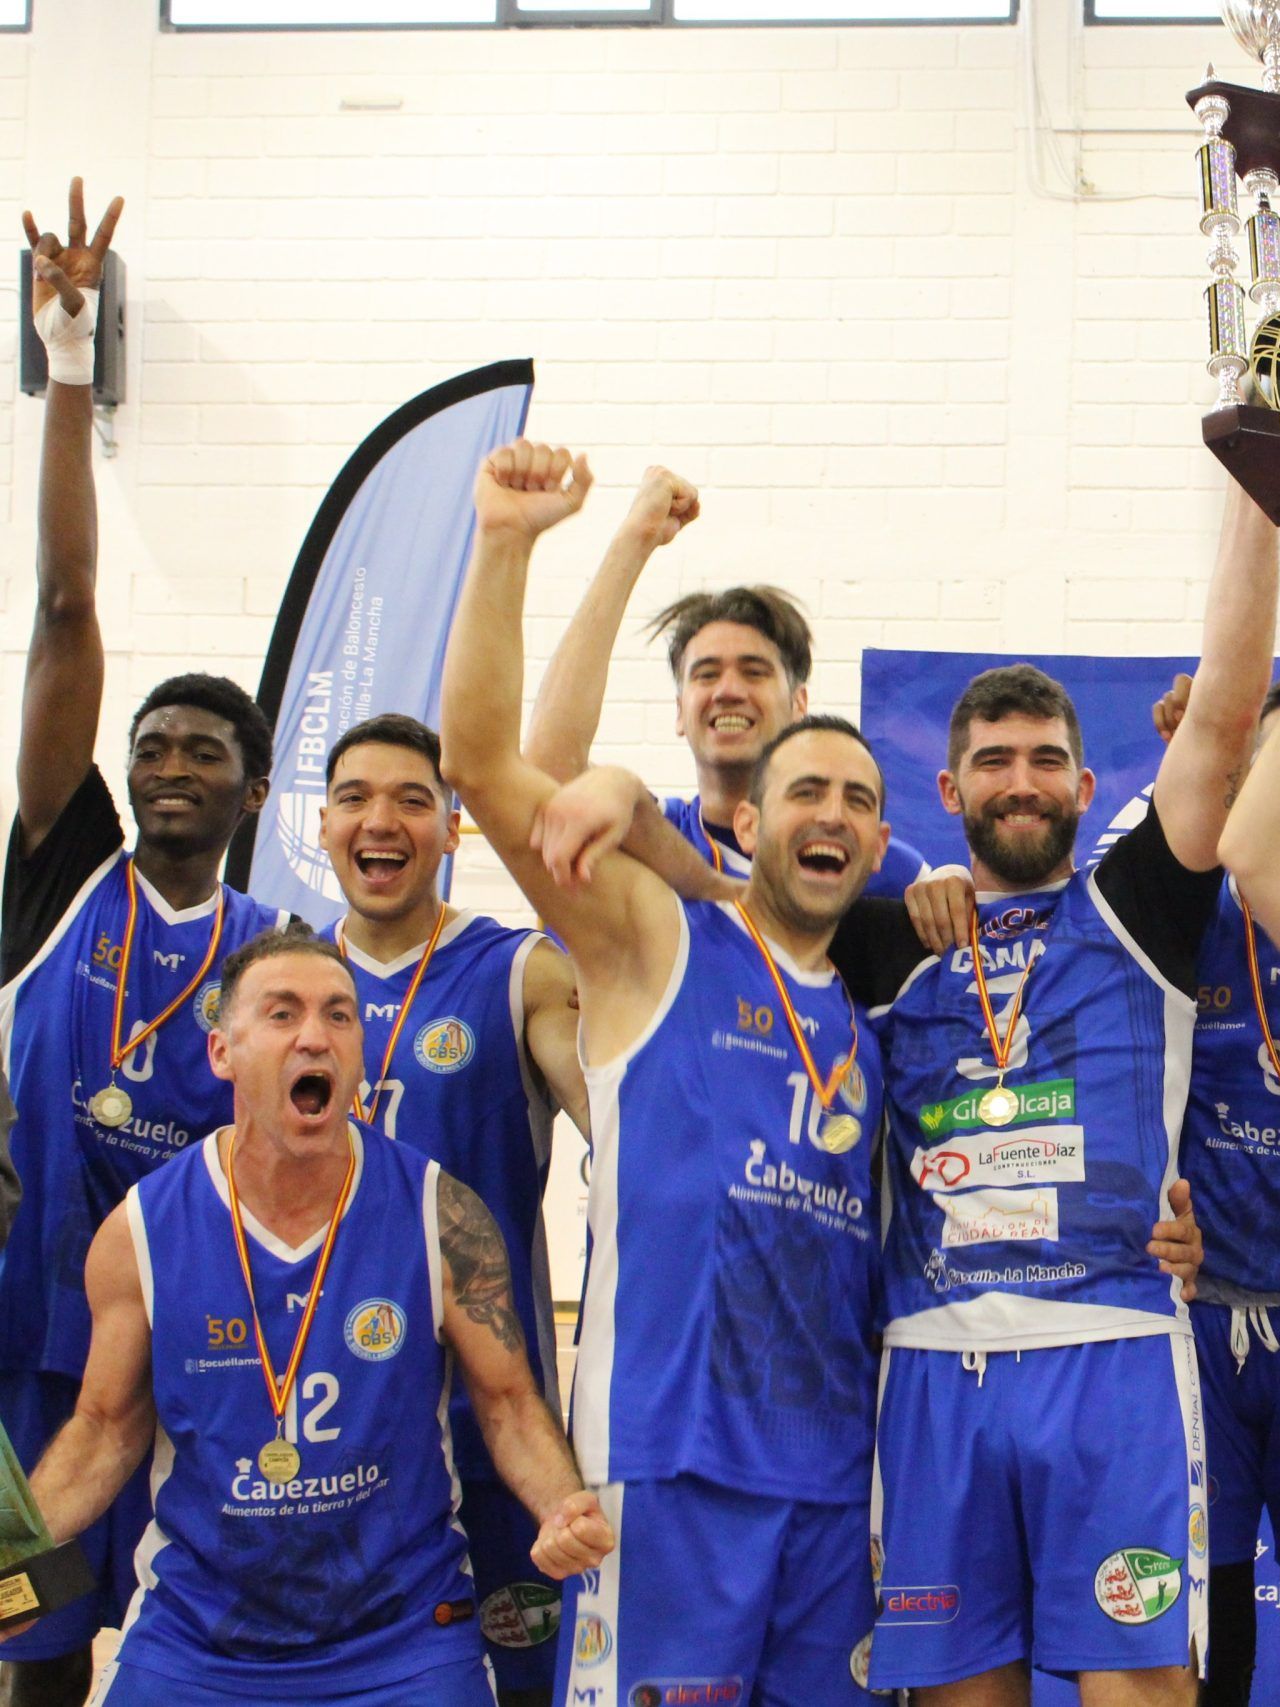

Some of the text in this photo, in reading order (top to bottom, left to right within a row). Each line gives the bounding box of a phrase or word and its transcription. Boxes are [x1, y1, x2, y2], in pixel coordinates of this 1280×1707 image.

[338, 567, 366, 741] ración de Baloncesto
[355, 596, 383, 726] tilla-La Mancha
[297, 671, 333, 773] FBCLM
[737, 1000, 774, 1034] 50
[953, 1090, 1072, 1121] Gllcaja
[979, 1143, 1076, 1166] LaFuente Díaz
[1256, 1145, 1270, 1156] de
[1016, 1170, 1036, 1179] S.L.
[1026, 1262, 1085, 1283] Mancha
[207, 1318, 247, 1345] 50
[199, 1357, 262, 1374] Socuéllamo
[276, 1371, 341, 1444] 12
[231, 1465, 379, 1501] Cabezuelo
[221, 1503, 276, 1517] Alimentos
[279, 1504, 294, 1516] de
[297, 1503, 309, 1514] la
[313, 1500, 345, 1513] tierra
[346, 1497, 355, 1508] y
[355, 1488, 371, 1502] del
